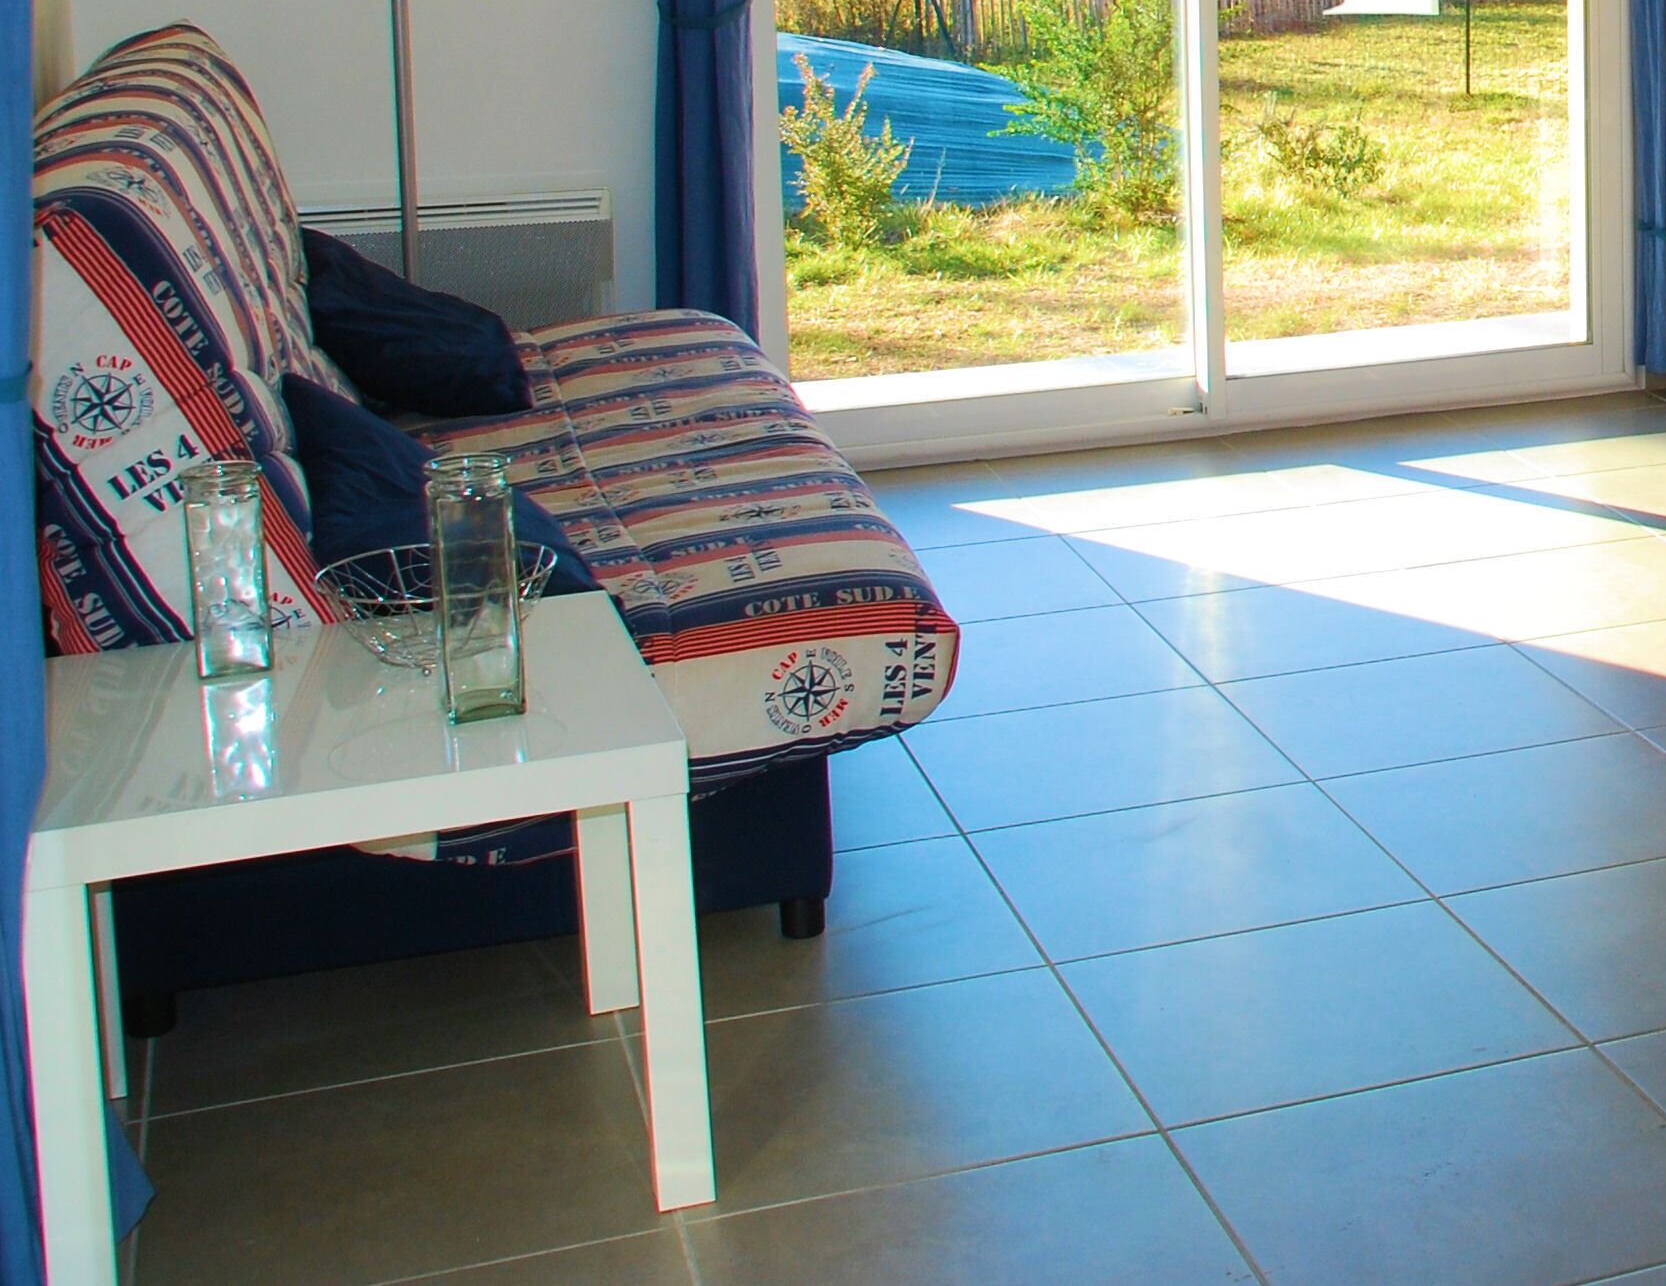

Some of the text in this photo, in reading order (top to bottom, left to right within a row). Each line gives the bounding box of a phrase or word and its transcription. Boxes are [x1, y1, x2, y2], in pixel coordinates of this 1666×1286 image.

[152, 280, 209, 356] COTE
[69, 362, 84, 377] N
[96, 355, 132, 370] CAP
[133, 373, 146, 385] E
[58, 422, 69, 434] O
[108, 434, 201, 501] LES 4
[44, 524, 87, 584] COE
[270, 592, 292, 605] AP
[744, 591, 820, 617] COTE
[805, 648, 817, 658] E
[911, 604, 938, 700] VENTS
[772, 652, 798, 681] CAP
[880, 638, 908, 716] LES 4
[844, 683, 855, 693] S
[764, 692, 776, 703] N
[819, 698, 849, 728] MER
[801, 724, 812, 734] O
